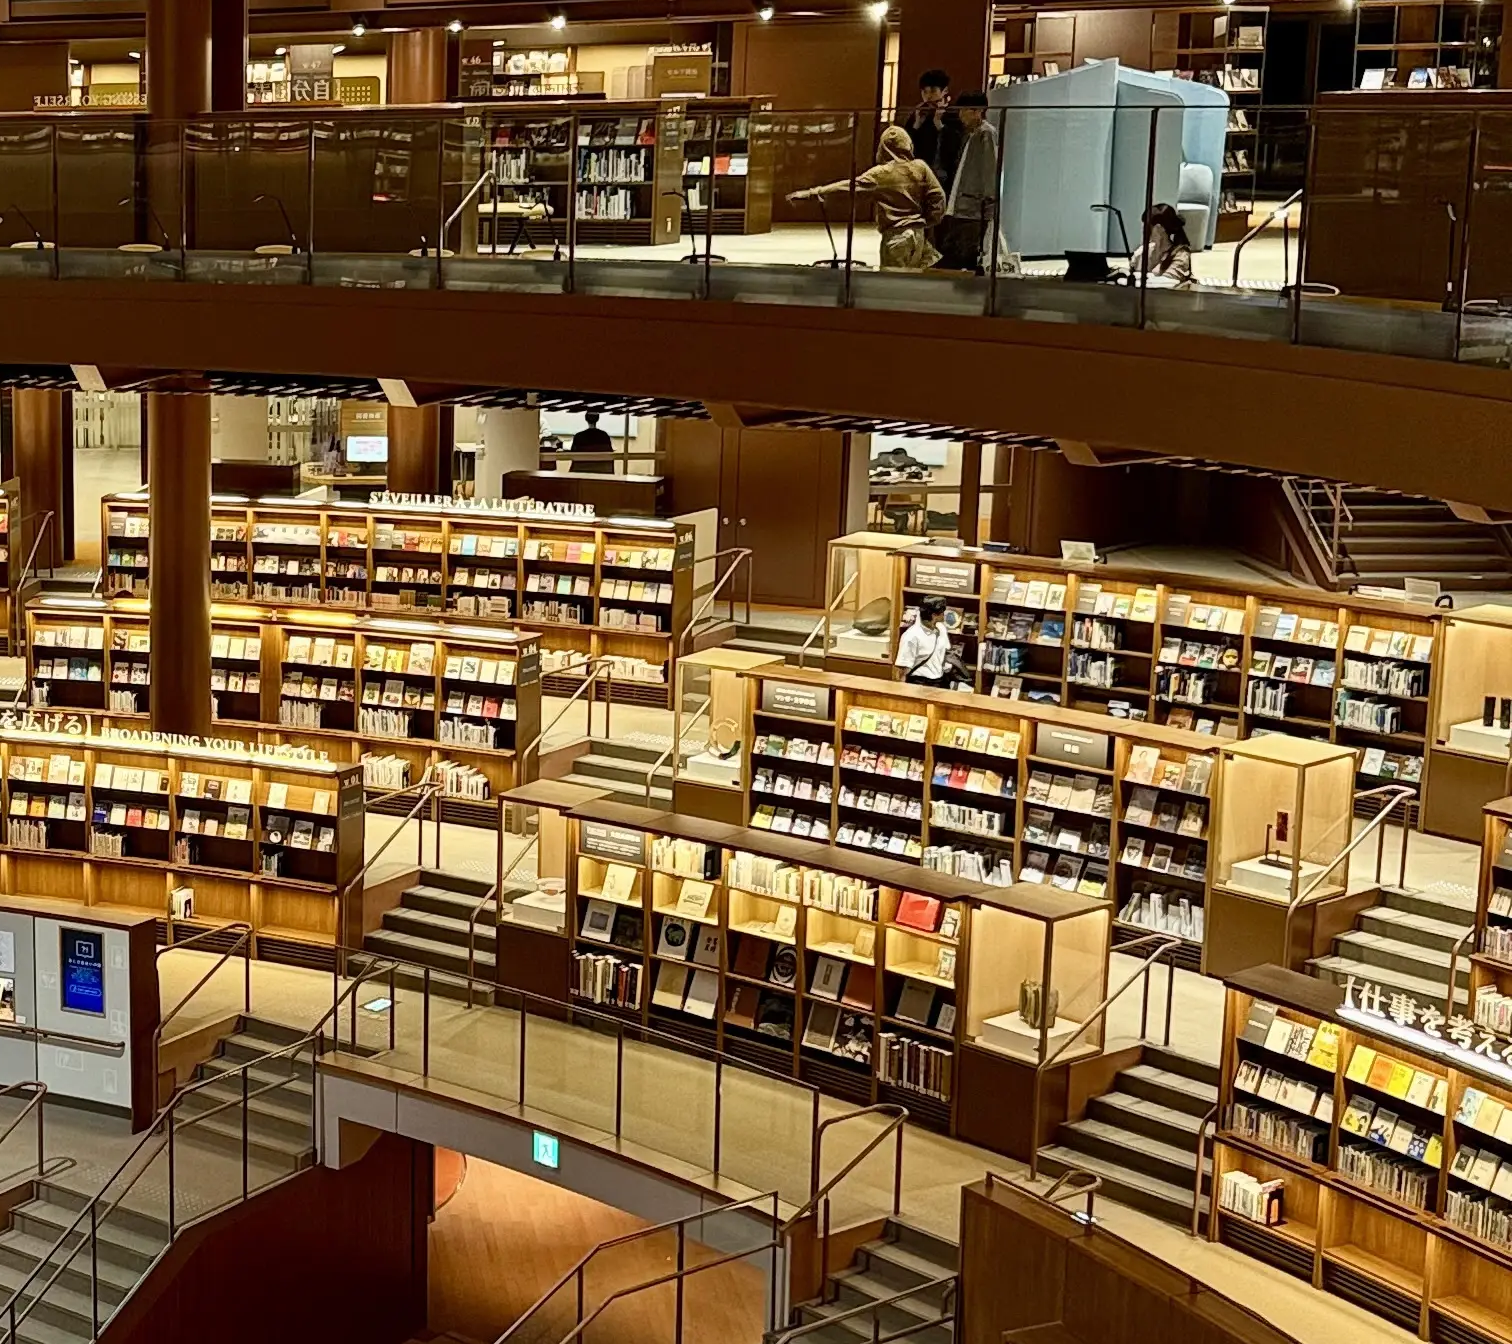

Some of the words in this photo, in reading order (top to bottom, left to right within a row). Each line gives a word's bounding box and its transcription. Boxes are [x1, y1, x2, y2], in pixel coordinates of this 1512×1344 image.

[370, 490, 452, 507] S'ÉVEILLER
[470, 497, 488, 509] LA
[100, 727, 201, 748] BROADENING
[203, 736, 245, 755] YOUR
